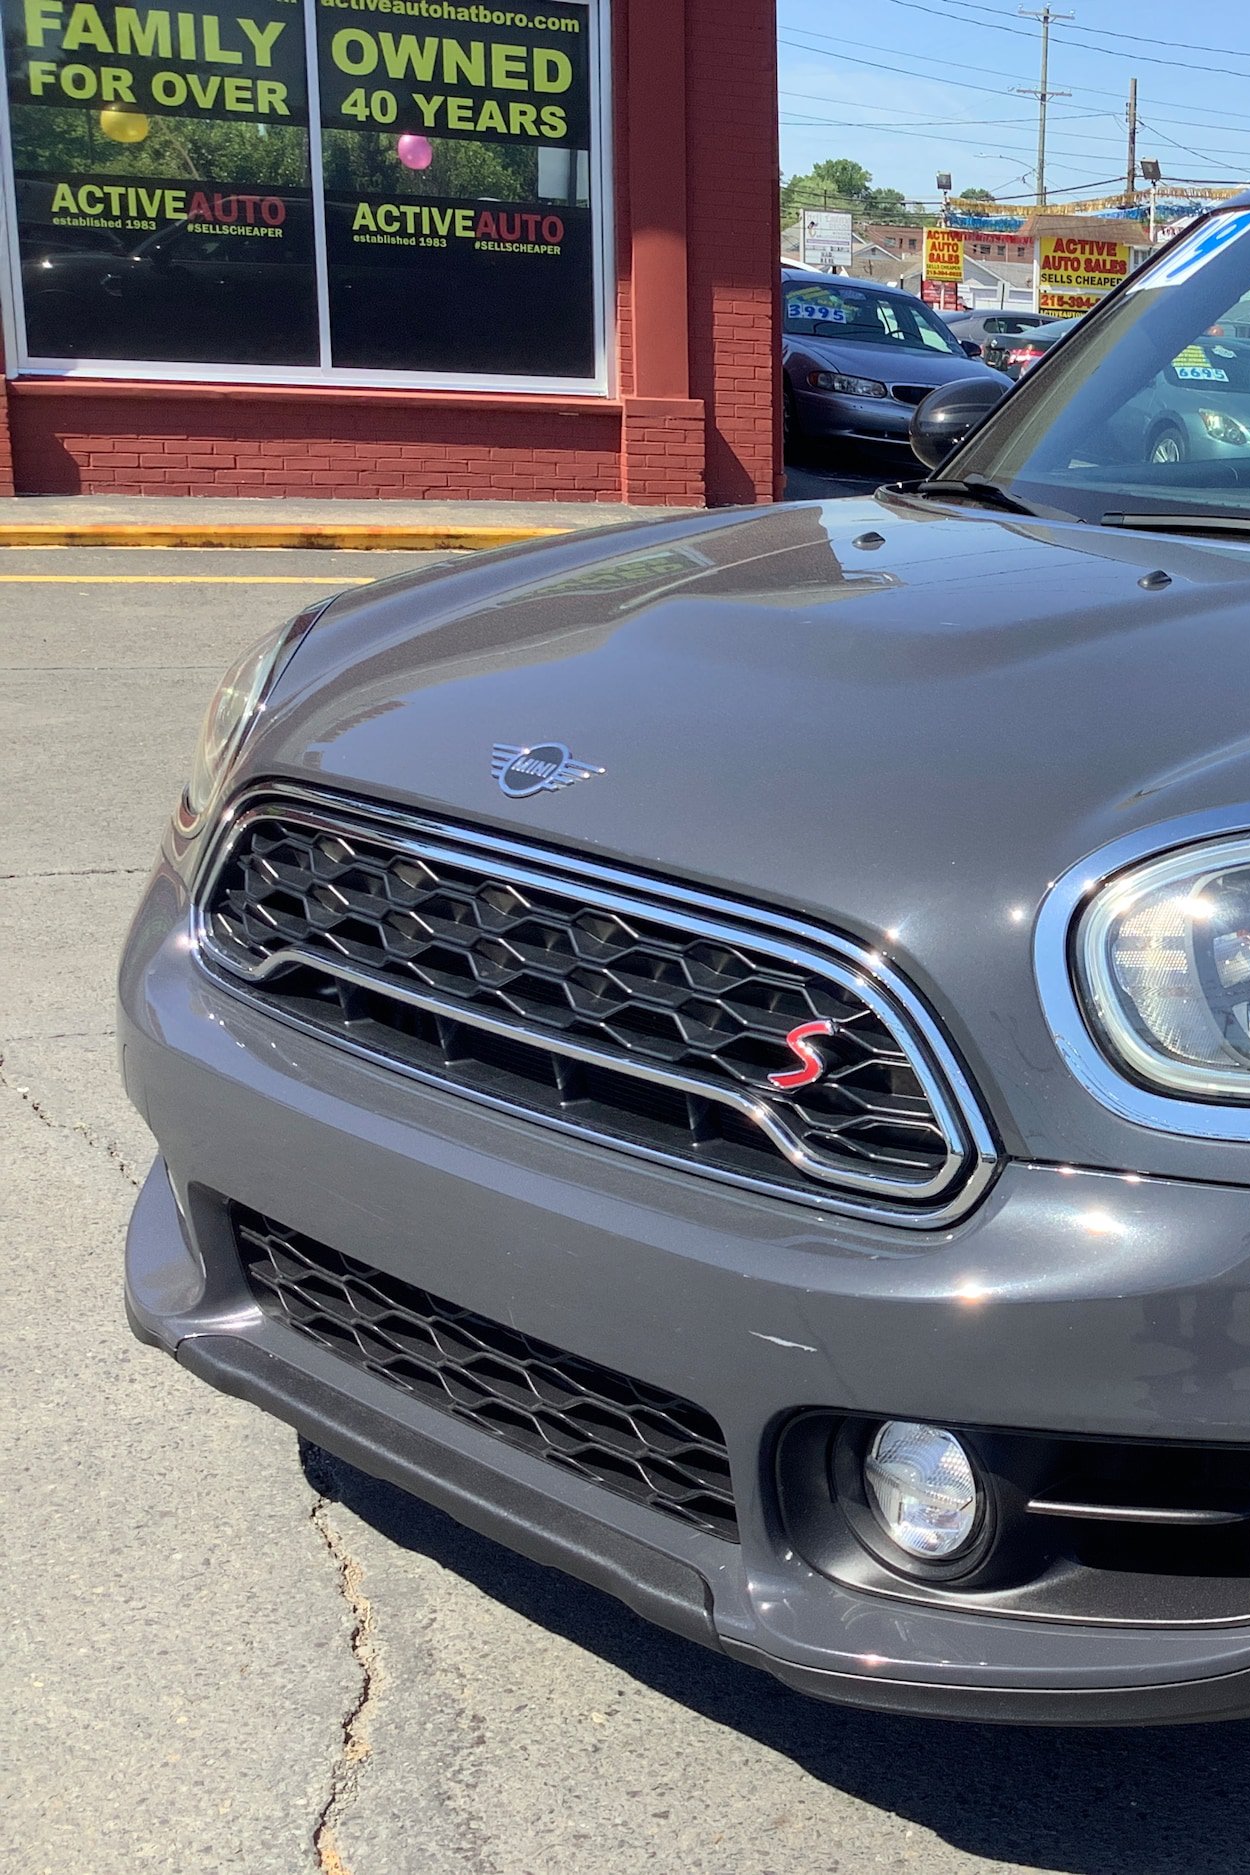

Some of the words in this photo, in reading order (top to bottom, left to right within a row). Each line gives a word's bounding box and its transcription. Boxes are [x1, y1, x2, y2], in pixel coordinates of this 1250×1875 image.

[25, 0, 286, 67] FAMILY
[331, 27, 573, 94] OWNED
[28, 60, 136, 103] FOR
[151, 71, 290, 116] OVER
[341, 87, 398, 124] 40
[412, 93, 568, 139] YEARS
[52, 216, 122, 229] established
[125, 220, 157, 231] 1983
[186, 223, 283, 238] #SELLSCHEAPER
[353, 234, 416, 246] established
[418, 237, 448, 248] 1983
[474, 241, 561, 255] #SELLSCHEAPER
[929, 241, 959, 254] AUTO
[1053, 237, 1117, 257] ACTIVE
[928, 252, 960, 265] SALES
[1041, 255, 1080, 272] AUTO
[1084, 258, 1127, 275] SALES
[1041, 273, 1072, 284] SELLS
[1179, 368, 1225, 380] 6695
[510, 756, 557, 779] MINI
[767, 1020, 834, 1089] S
